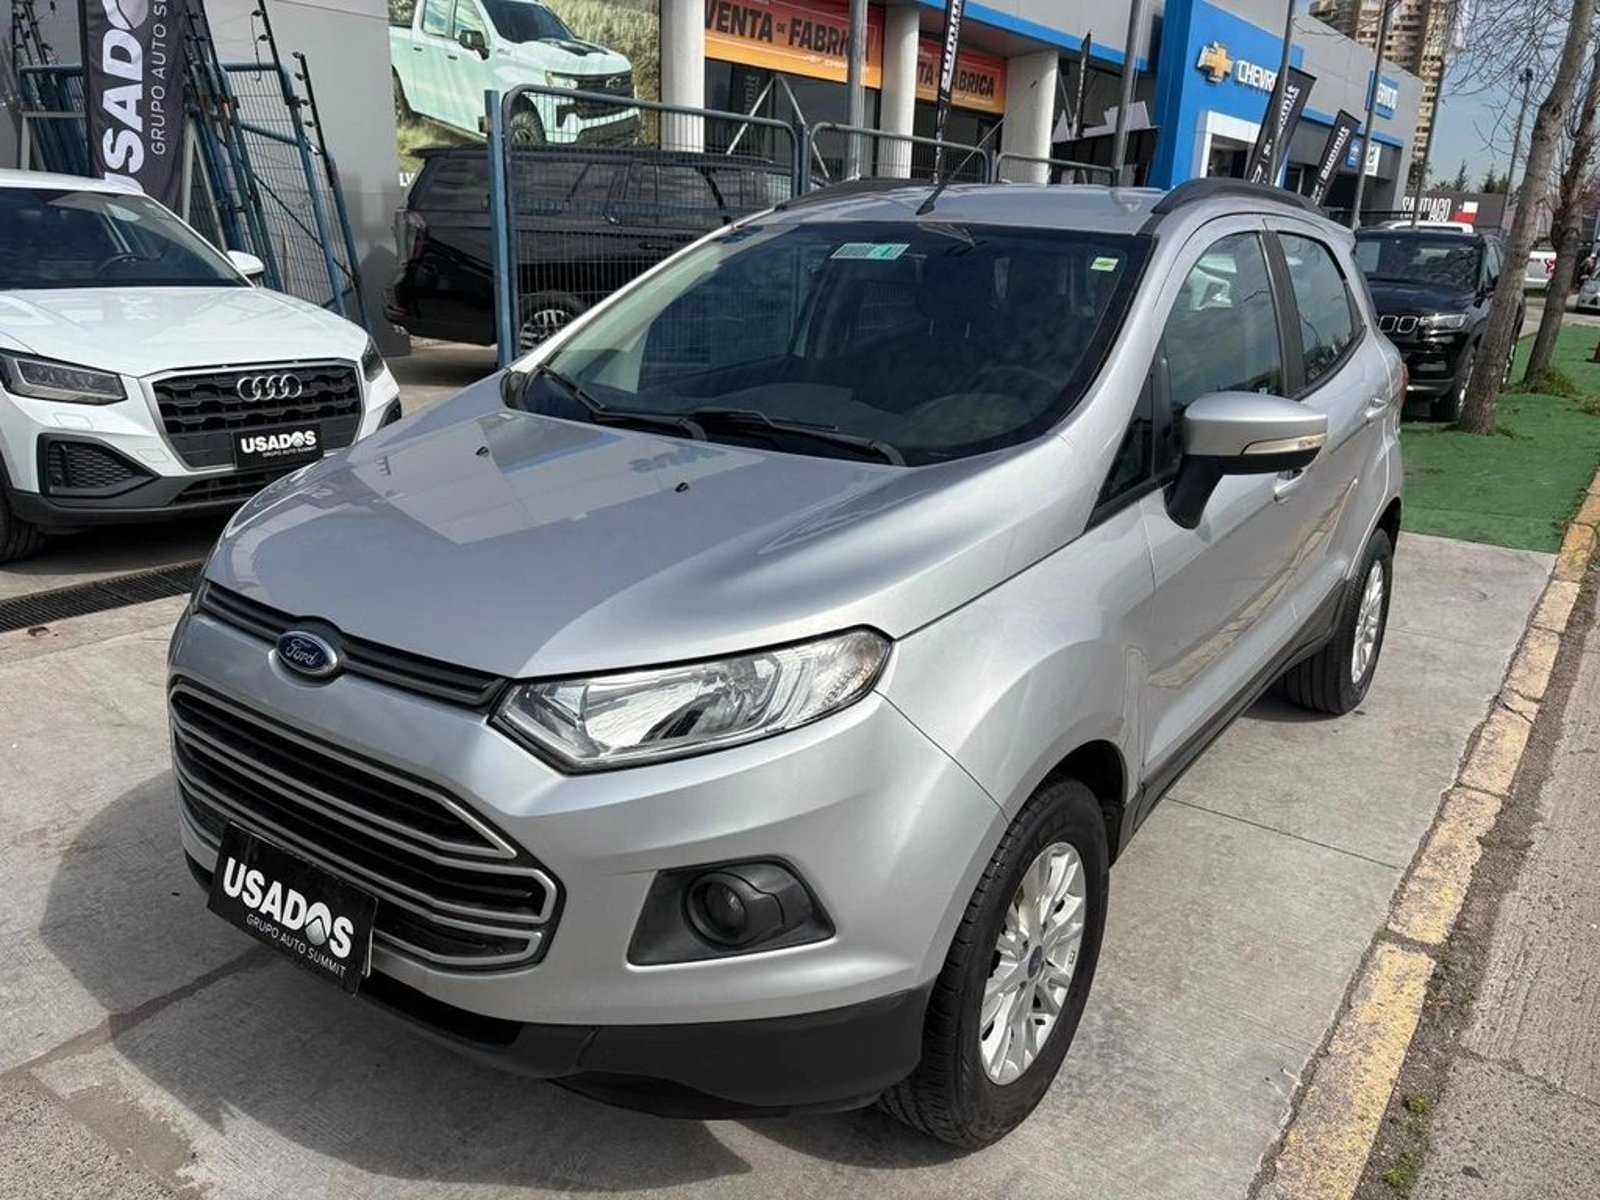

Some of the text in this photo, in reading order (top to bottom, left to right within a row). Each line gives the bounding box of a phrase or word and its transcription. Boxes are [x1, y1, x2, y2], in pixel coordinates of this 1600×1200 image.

[151, 23, 167, 80] AUTO
[705, 0, 773, 43] VENTA
[788, 18, 869, 62] FABRI
[952, 69, 995, 97] BRICA
[151, 85, 166, 155] GRUPO
[240, 430, 317, 454] USADOS
[285, 638, 319, 665] Ford
[223, 856, 354, 959] USADOS
[246, 913, 346, 977] GRUPO AUTO SUMMIT
